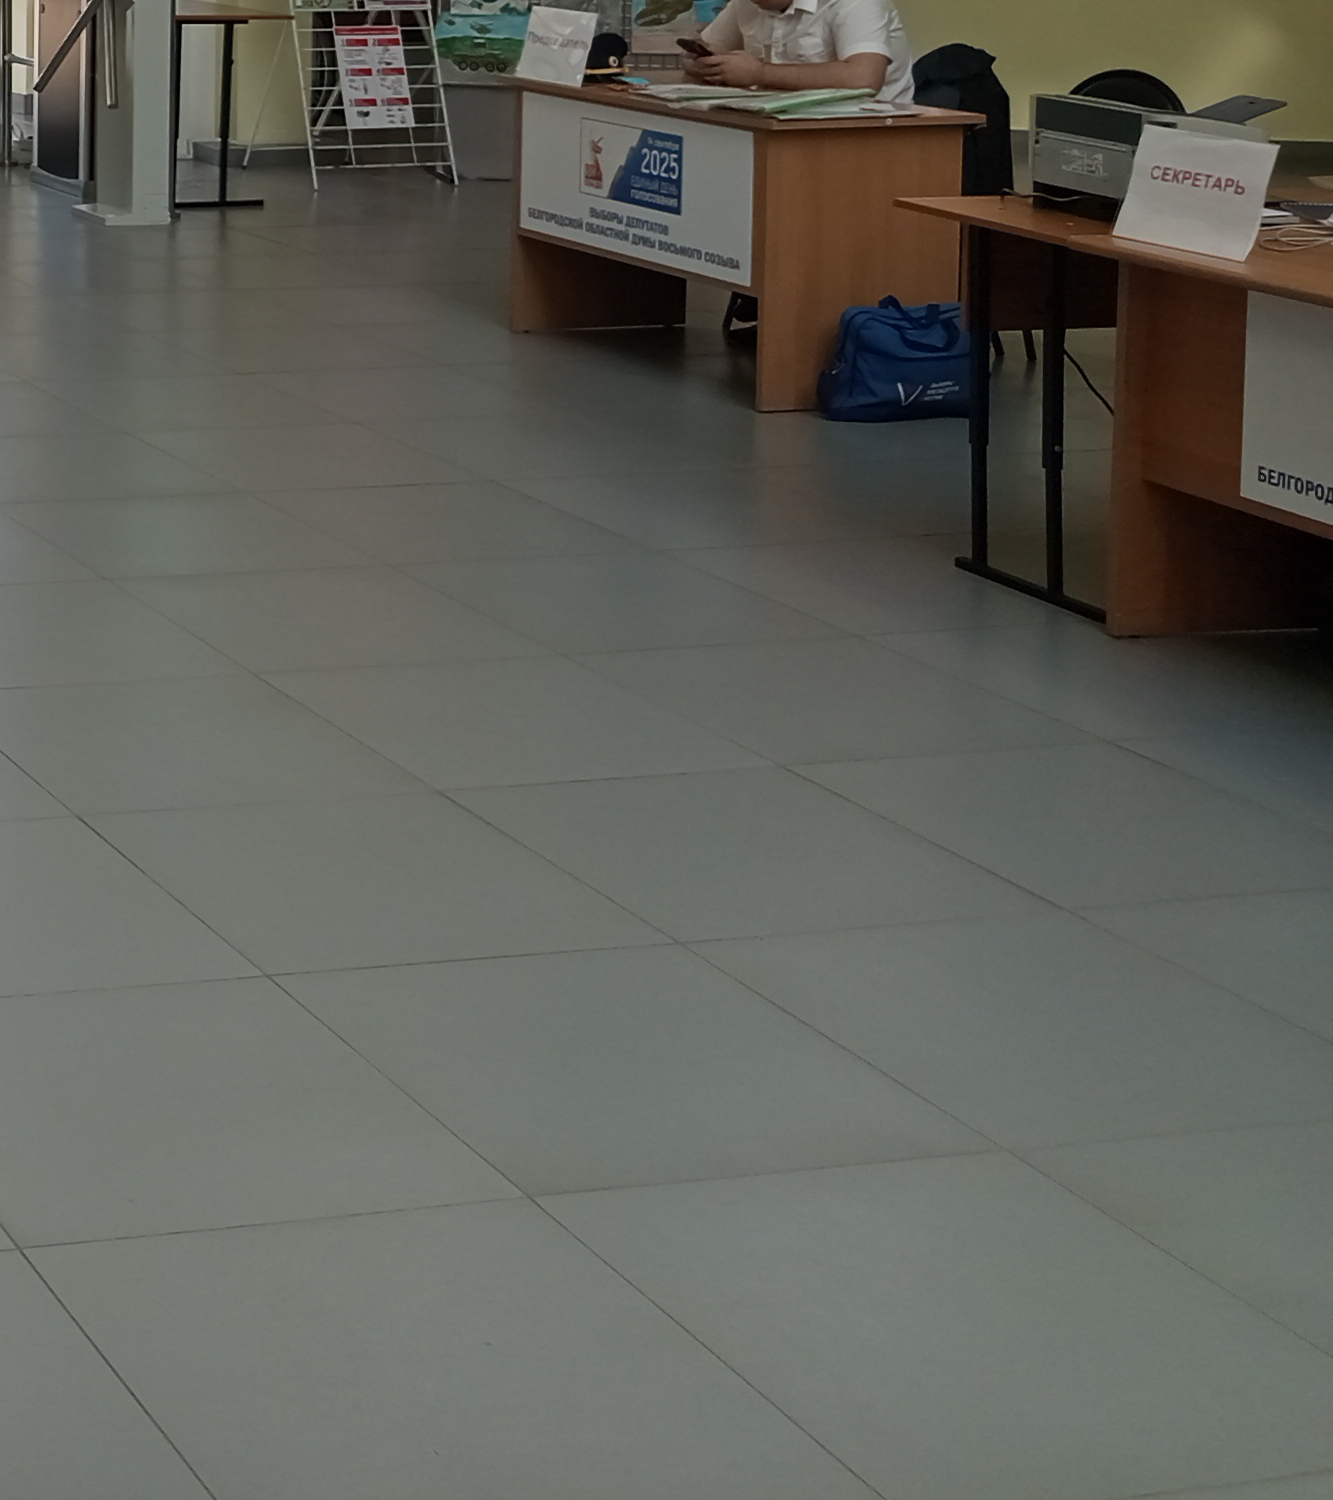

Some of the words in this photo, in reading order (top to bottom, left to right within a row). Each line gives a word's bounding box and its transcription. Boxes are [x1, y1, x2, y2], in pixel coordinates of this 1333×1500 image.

[640, 148, 680, 180] 2025
[1150, 165, 1246, 196] СЕКРЕТАРЬ
[589, 206, 625, 224] ВЫБОРЫ
[624, 215, 669, 236] ДЕПУТАТОВ
[527, 206, 584, 231] БЕЛГОРОДСКОЙ
[585, 221, 630, 243] ОБЛАСТНОЙ
[630, 233, 657, 249] ДУМЫ
[658, 241, 703, 261] ВОСЬМОГО
[703, 253, 741, 271] СОЗЫВА
[1257, 465, 1333, 507] БЕЛГОРОД
